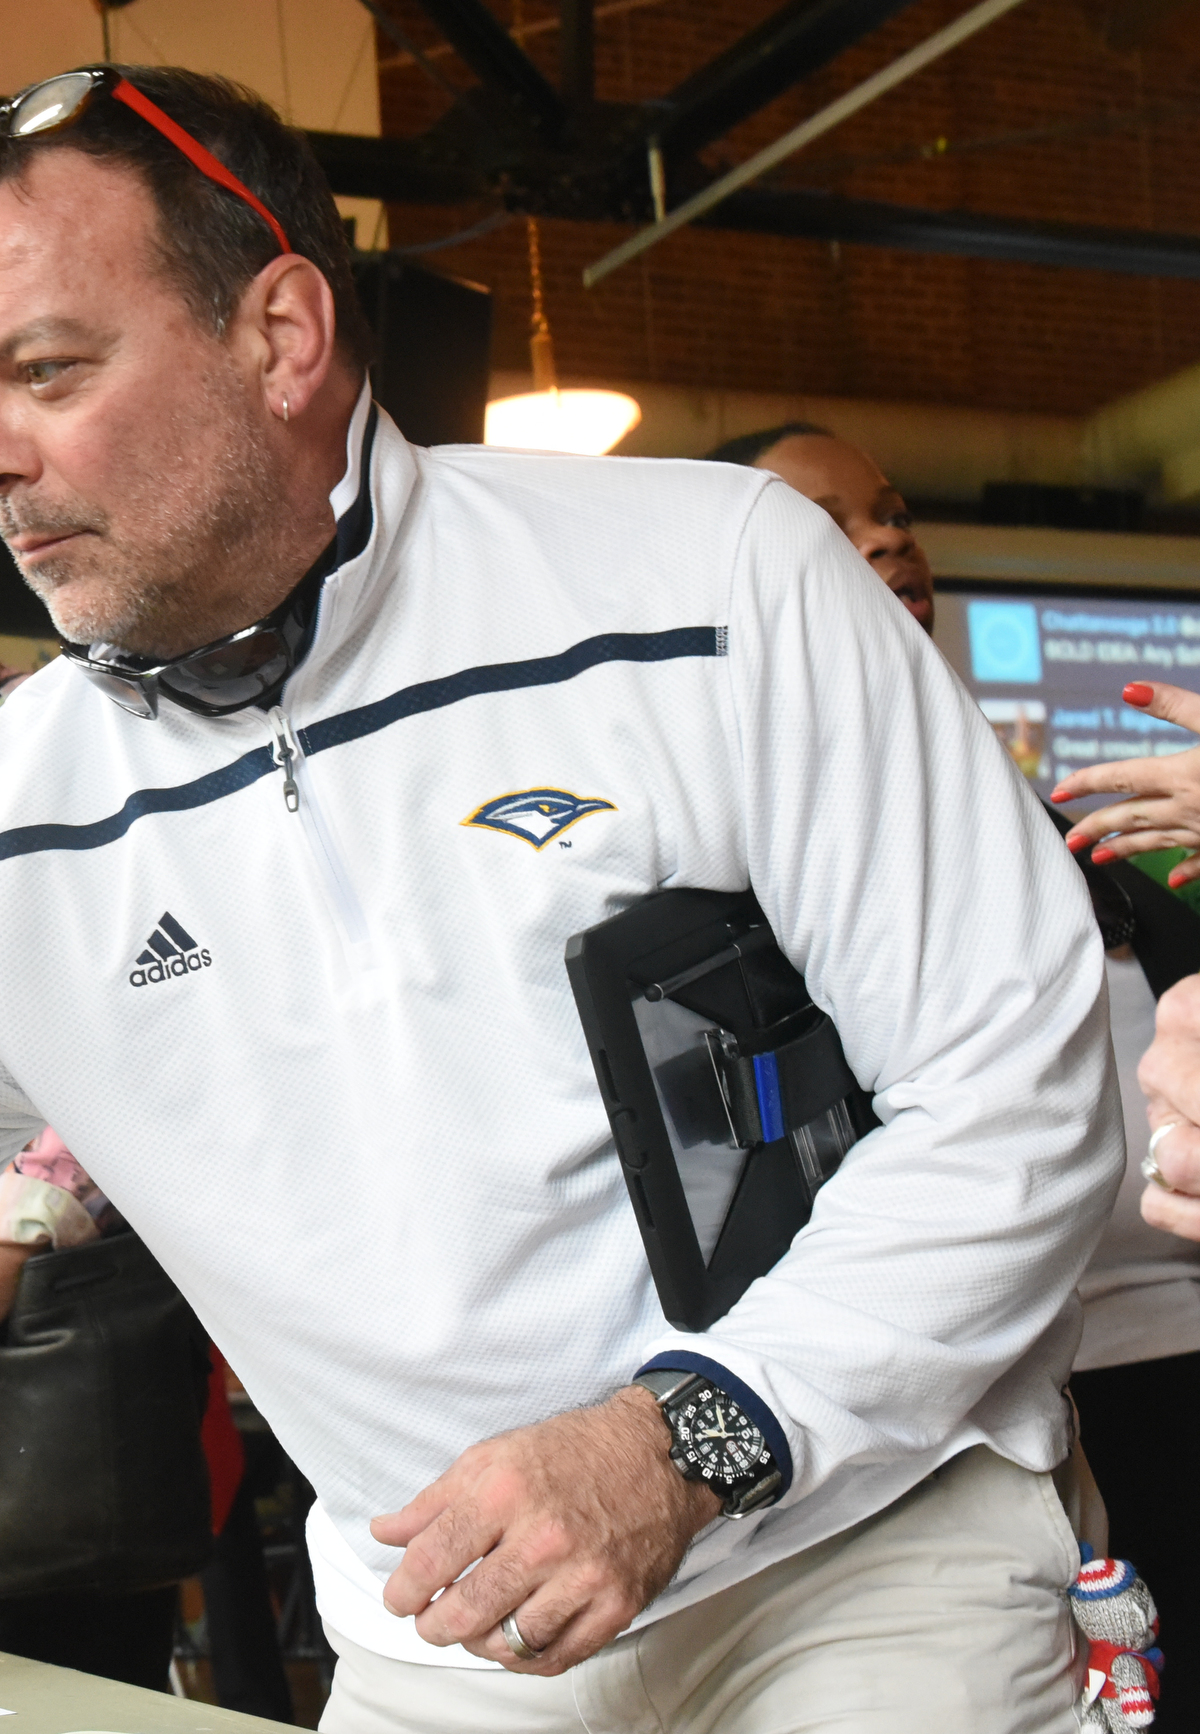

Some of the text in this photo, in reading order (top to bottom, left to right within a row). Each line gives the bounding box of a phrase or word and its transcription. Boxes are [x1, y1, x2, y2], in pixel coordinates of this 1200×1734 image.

[129, 948, 212, 987] adidas
[698, 1389, 713, 1402] 30
[685, 1404, 697, 1419] 25
[681, 1427, 690, 1440] 20
[740, 1427, 753, 1440] 10
[686, 1450, 698, 1463] 15
[732, 1450, 745, 1463] 12
[759, 1450, 771, 1465] 55
[701, 1467, 714, 1480] 10
[725, 1475, 733, 1485] 5
